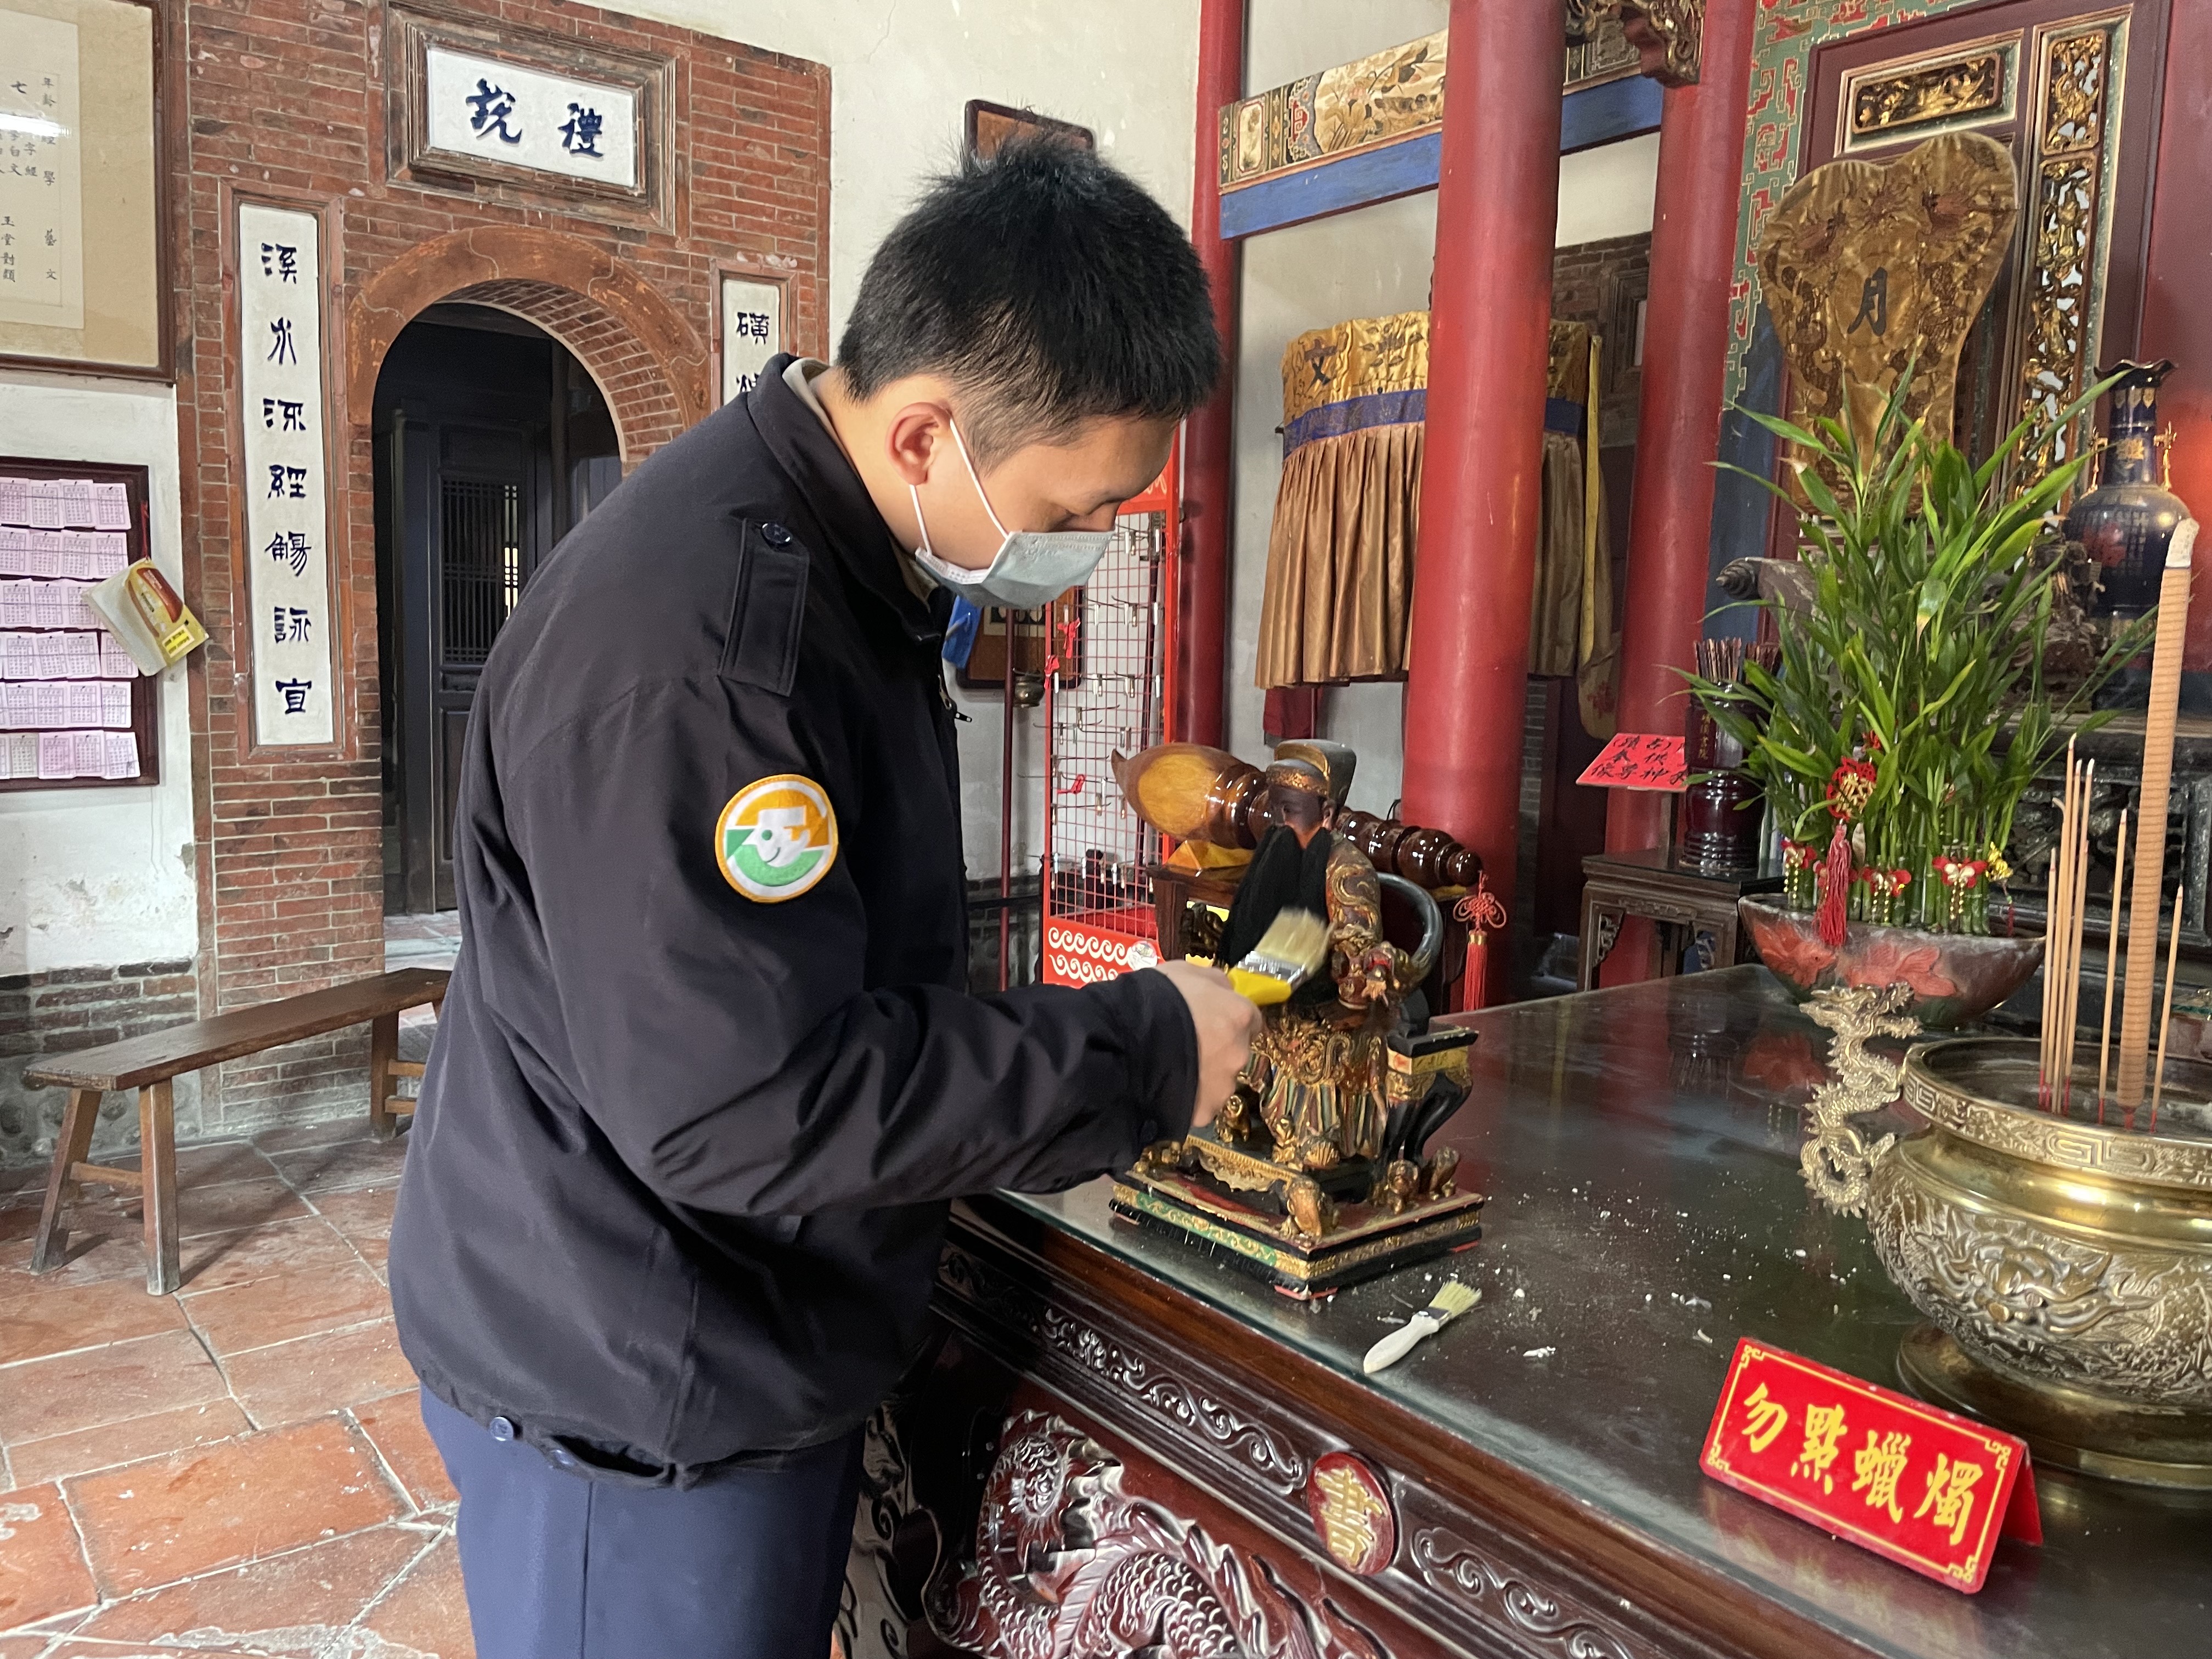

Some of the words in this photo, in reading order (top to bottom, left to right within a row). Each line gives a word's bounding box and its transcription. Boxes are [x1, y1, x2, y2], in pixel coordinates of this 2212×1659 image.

[10, 81, 27, 94] 七
[1847, 266, 1888, 337] 月
[1741, 1382, 1984, 1547] 勿點蠟燭
